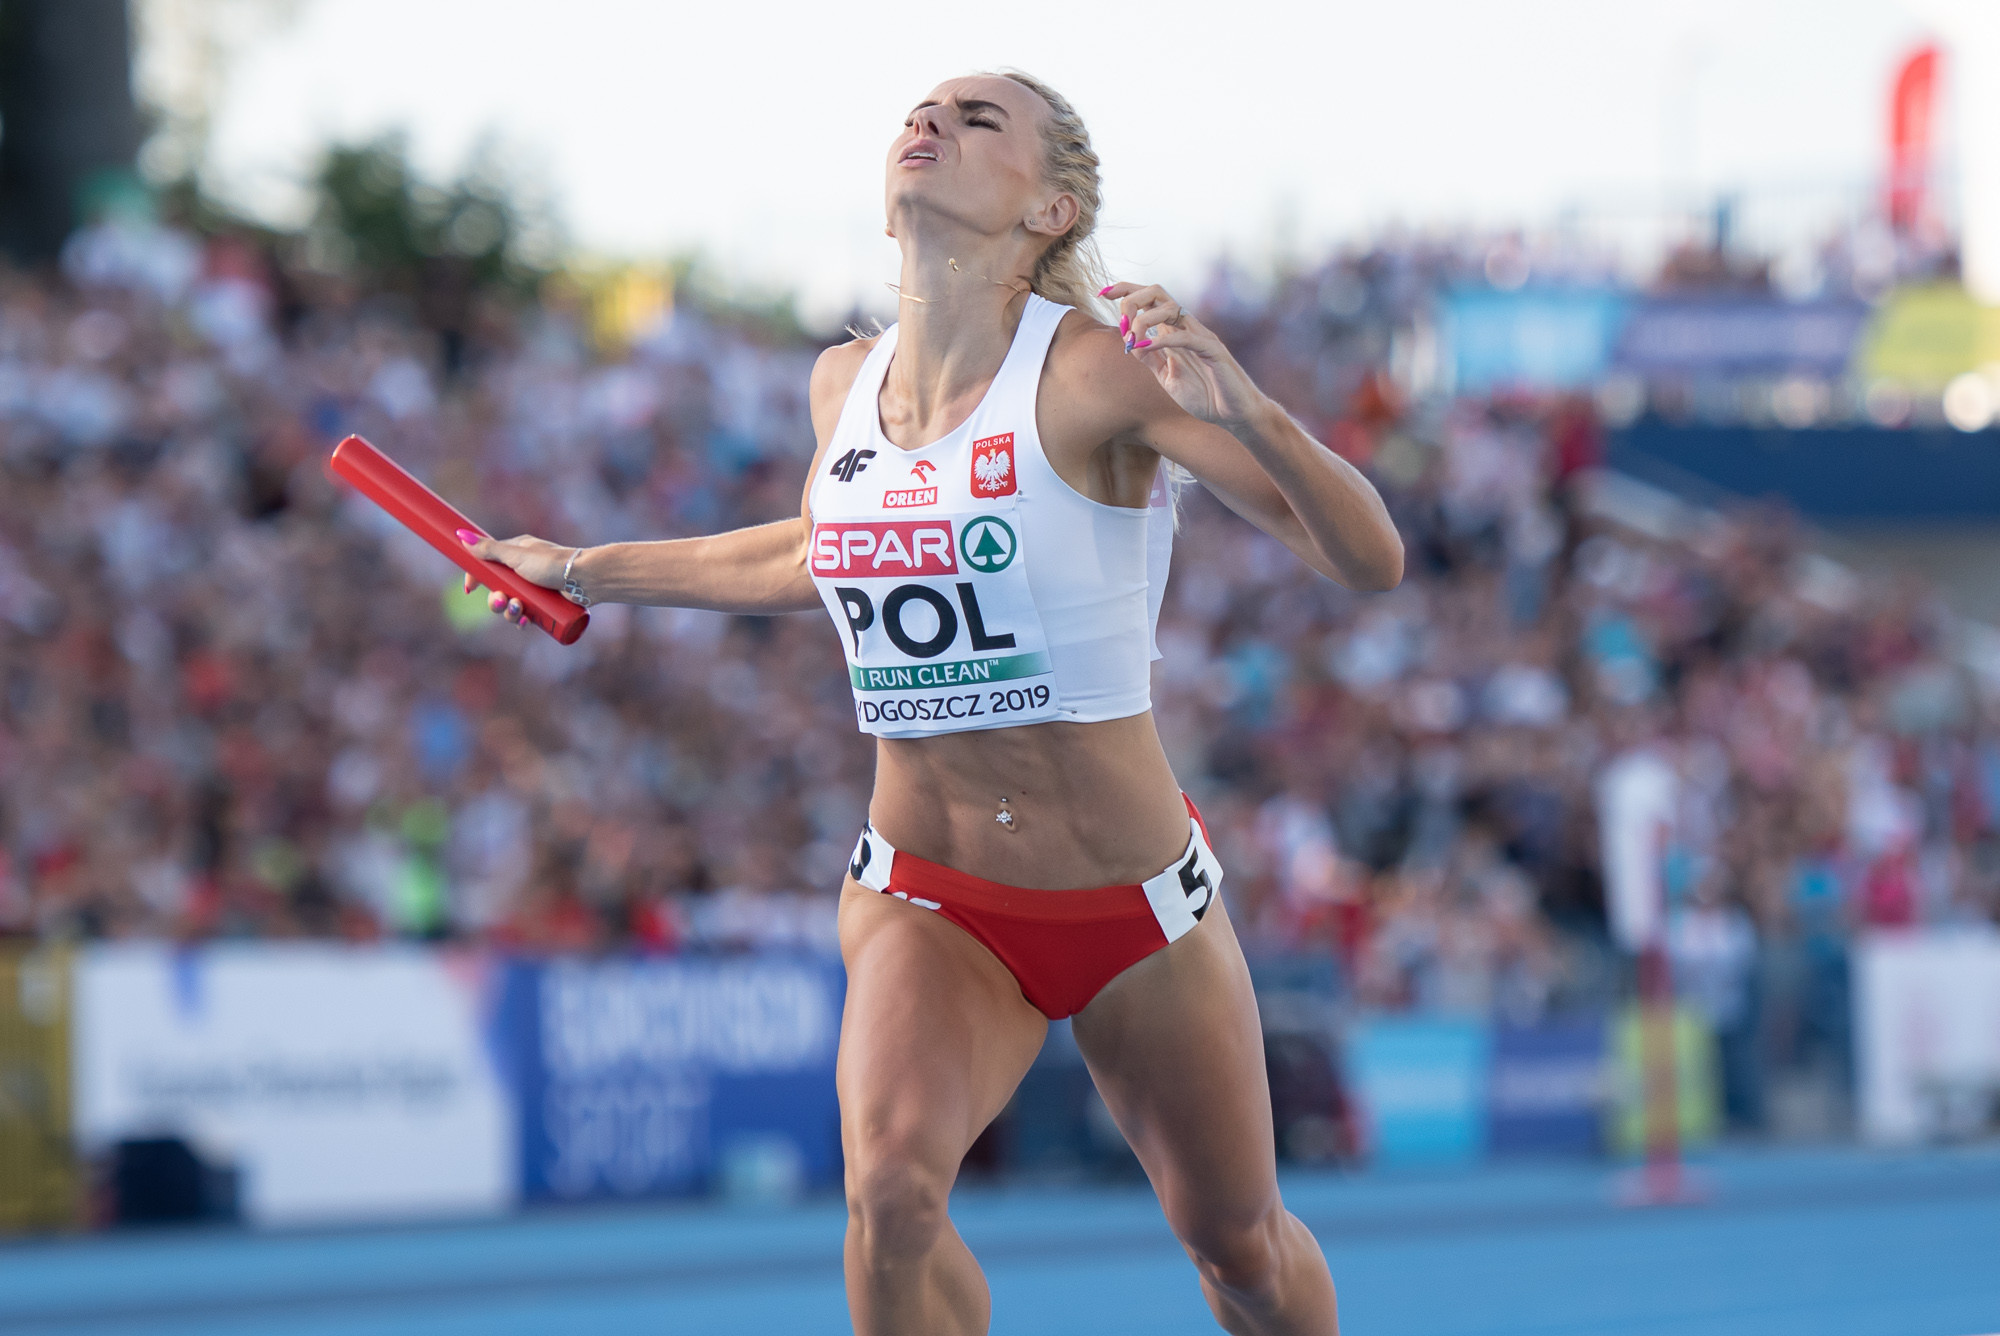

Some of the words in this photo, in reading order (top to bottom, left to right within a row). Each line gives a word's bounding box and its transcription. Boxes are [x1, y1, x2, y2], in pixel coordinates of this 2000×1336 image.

[975, 435, 1012, 450] POLSKA
[885, 489, 936, 507] ORLEN
[814, 527, 952, 571] SPAR
[834, 582, 1016, 660] POL
[859, 669, 866, 687] I
[868, 668, 913, 687] RUN
[855, 694, 985, 724] YDGOSZCZ
[992, 684, 1050, 713] 2019
[1177, 847, 1213, 922] 5
